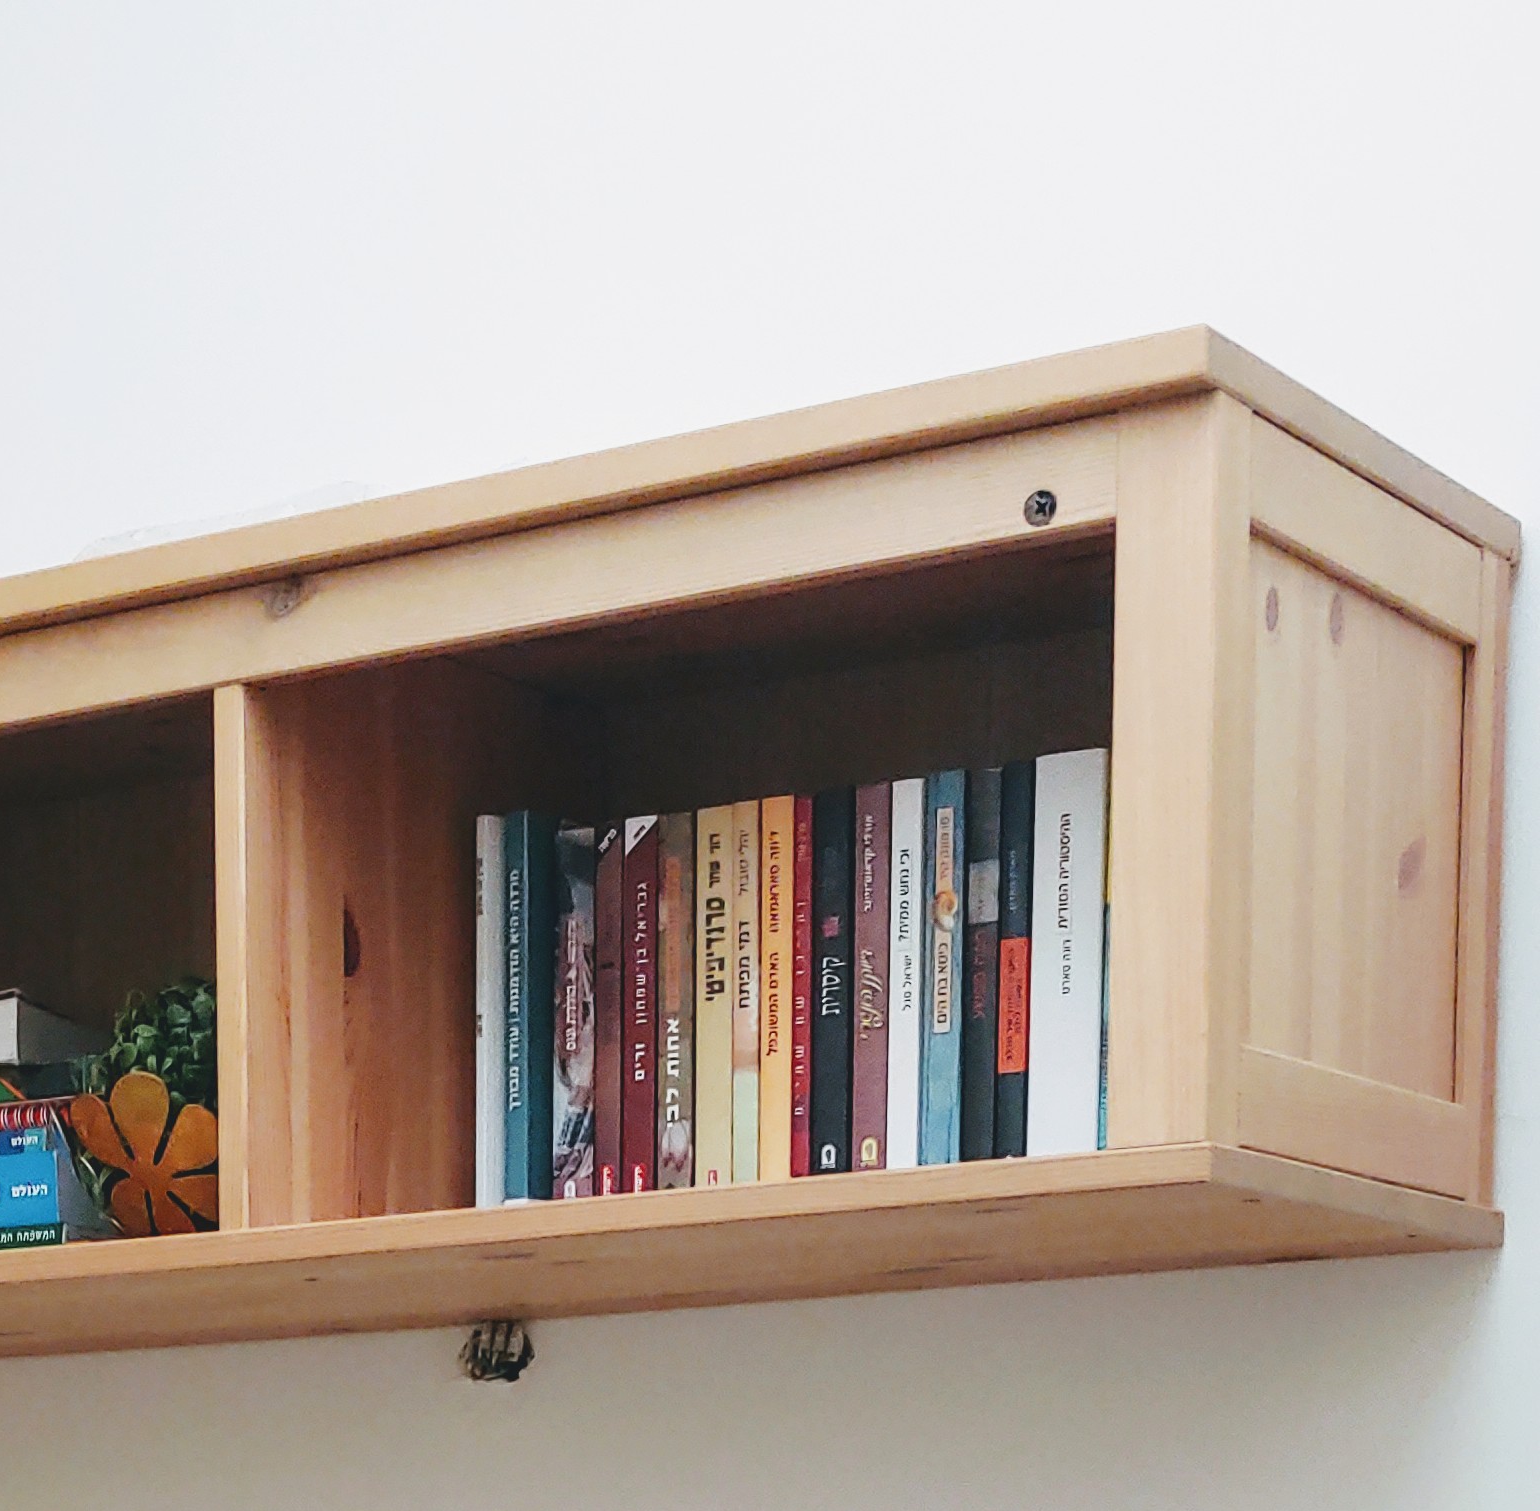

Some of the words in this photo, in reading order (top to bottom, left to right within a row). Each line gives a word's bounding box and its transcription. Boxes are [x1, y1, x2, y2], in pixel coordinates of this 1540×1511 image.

[899, 869, 910, 896] נחש
[739, 921, 750, 950] דמי
[739, 956, 750, 1008] מפתח
[821, 957, 846, 1014] קיסרית
[766, 993, 779, 1056] המשוכפל
[634, 1043, 645, 1081] זרים
[666, 1017, 679, 1078] אחות
[11, 1184, 48, 1197] העולם
